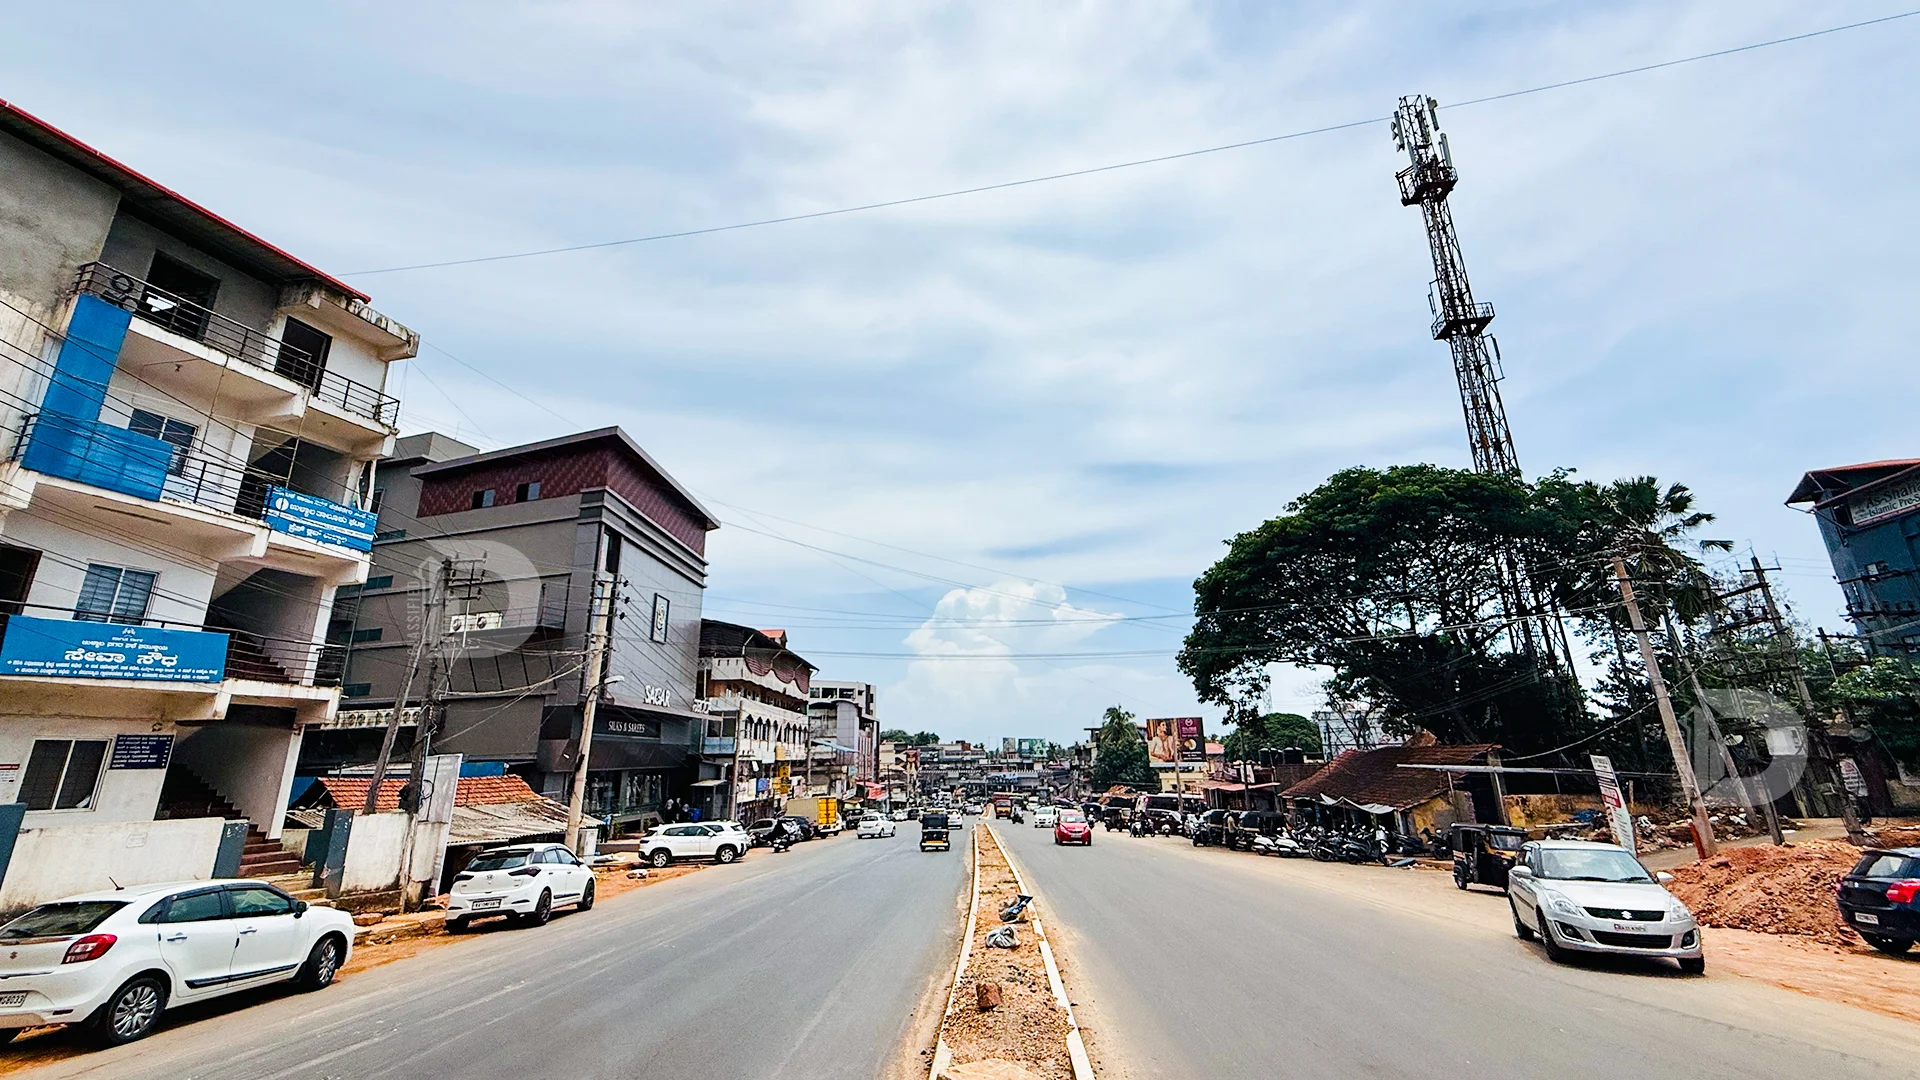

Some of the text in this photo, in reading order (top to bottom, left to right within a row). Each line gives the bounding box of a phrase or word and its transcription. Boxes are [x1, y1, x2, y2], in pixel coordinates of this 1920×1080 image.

[1869, 502, 1898, 517] Islamic
[64, 647, 178, 668] ಸೇವಾ ಸೌಧ
[644, 684, 671, 708] SAGAR
[608, 720, 623, 732] SILKS
